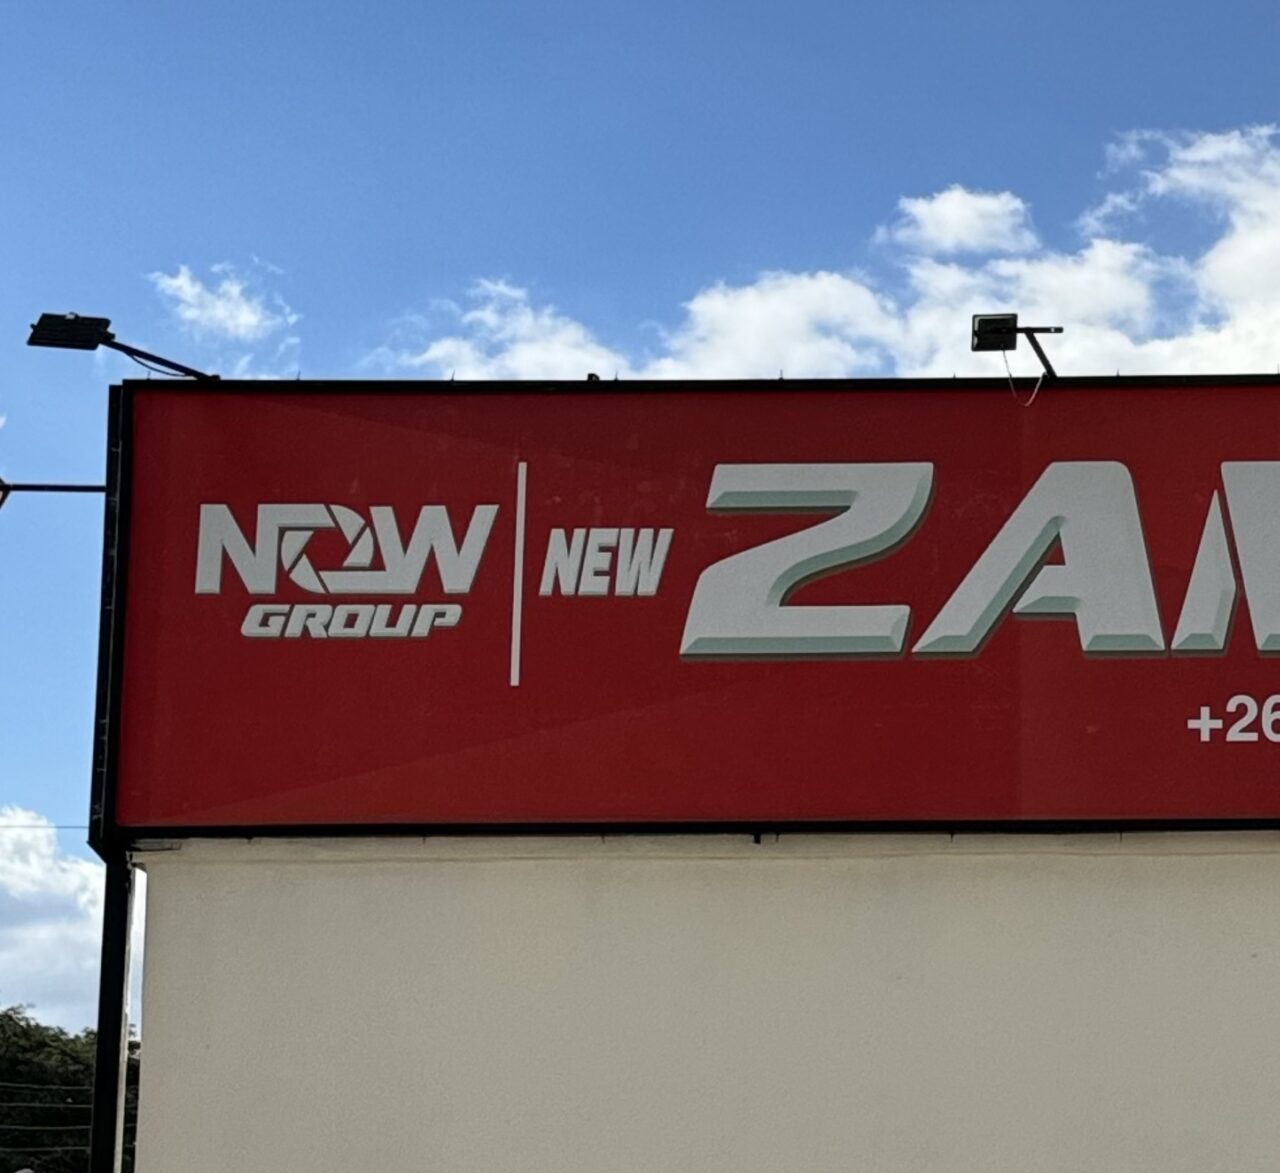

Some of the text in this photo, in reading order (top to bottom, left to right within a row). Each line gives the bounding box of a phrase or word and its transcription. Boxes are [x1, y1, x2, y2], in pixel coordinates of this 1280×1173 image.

[194, 503, 500, 595] NOW
[538, 527, 675, 597] NEW
[240, 603, 463, 639] GROUP
